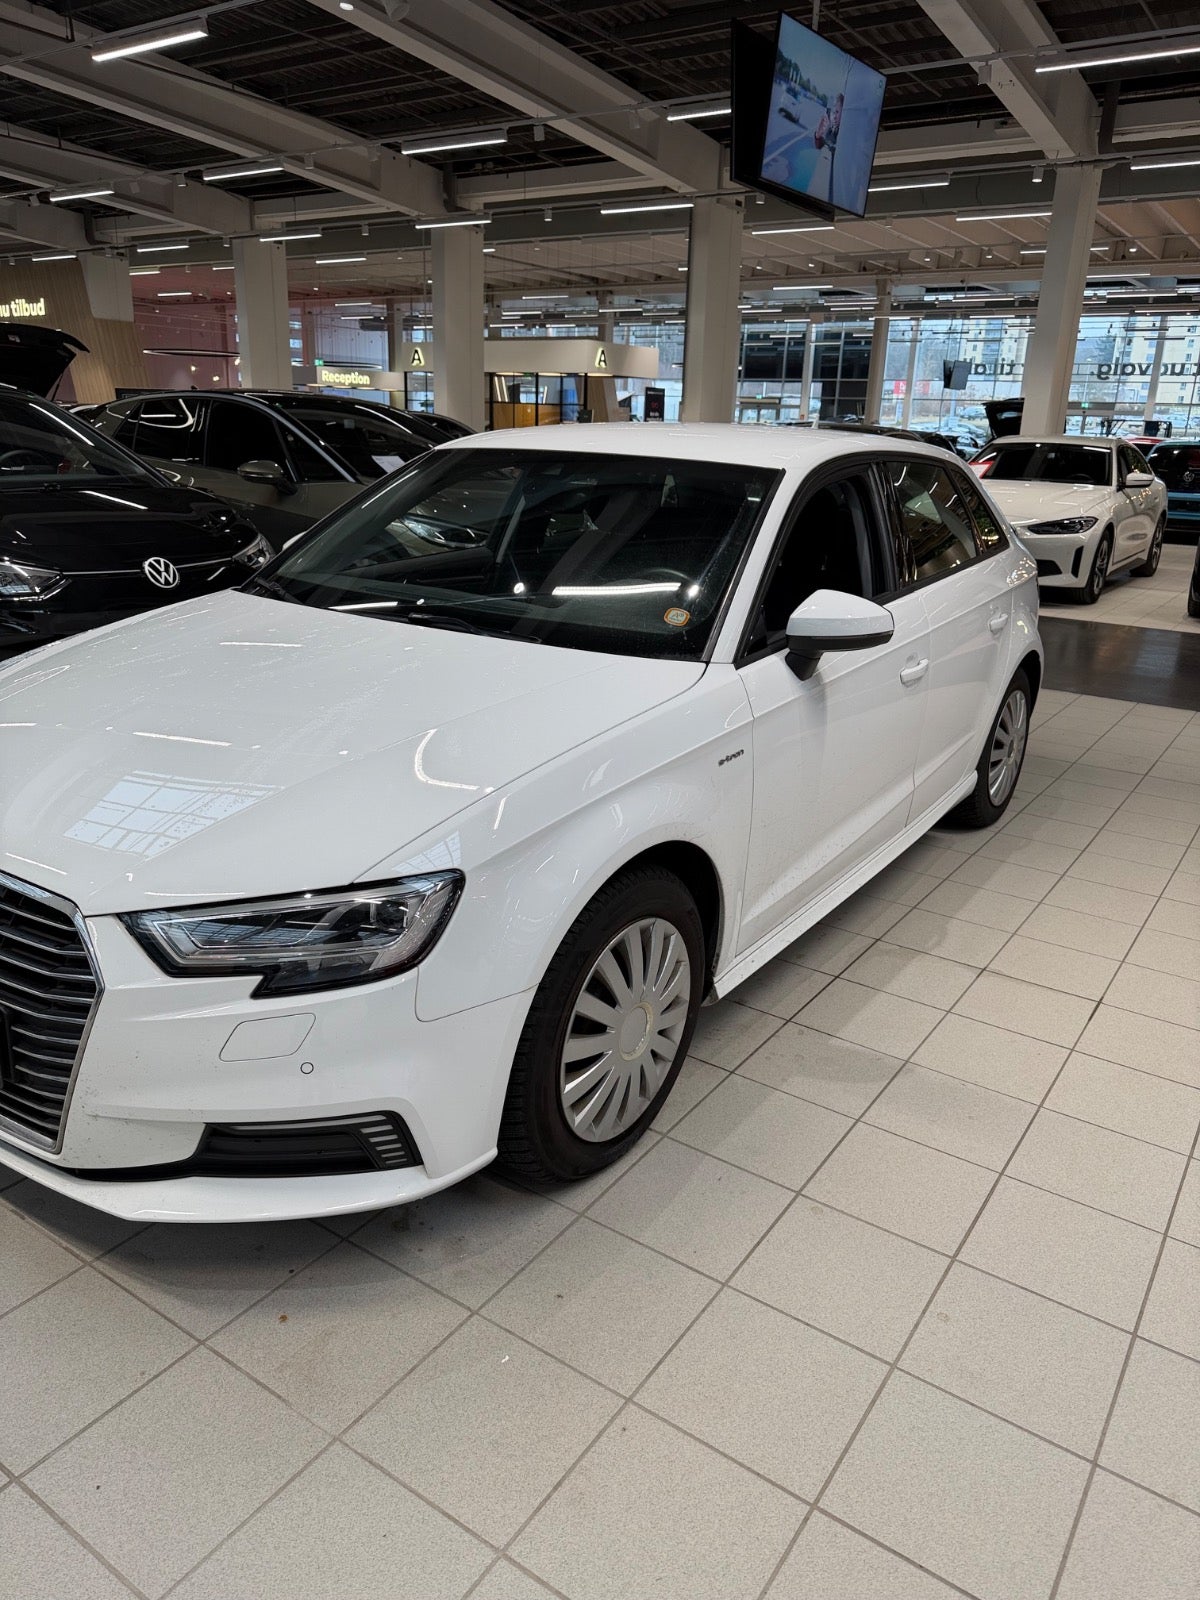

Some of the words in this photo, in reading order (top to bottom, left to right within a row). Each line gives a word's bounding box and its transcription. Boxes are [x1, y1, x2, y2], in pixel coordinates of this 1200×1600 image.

[10, 297, 46, 317] tilbud
[411, 347, 425, 366] A
[594, 347, 607, 368] A
[321, 370, 371, 385] Reception
